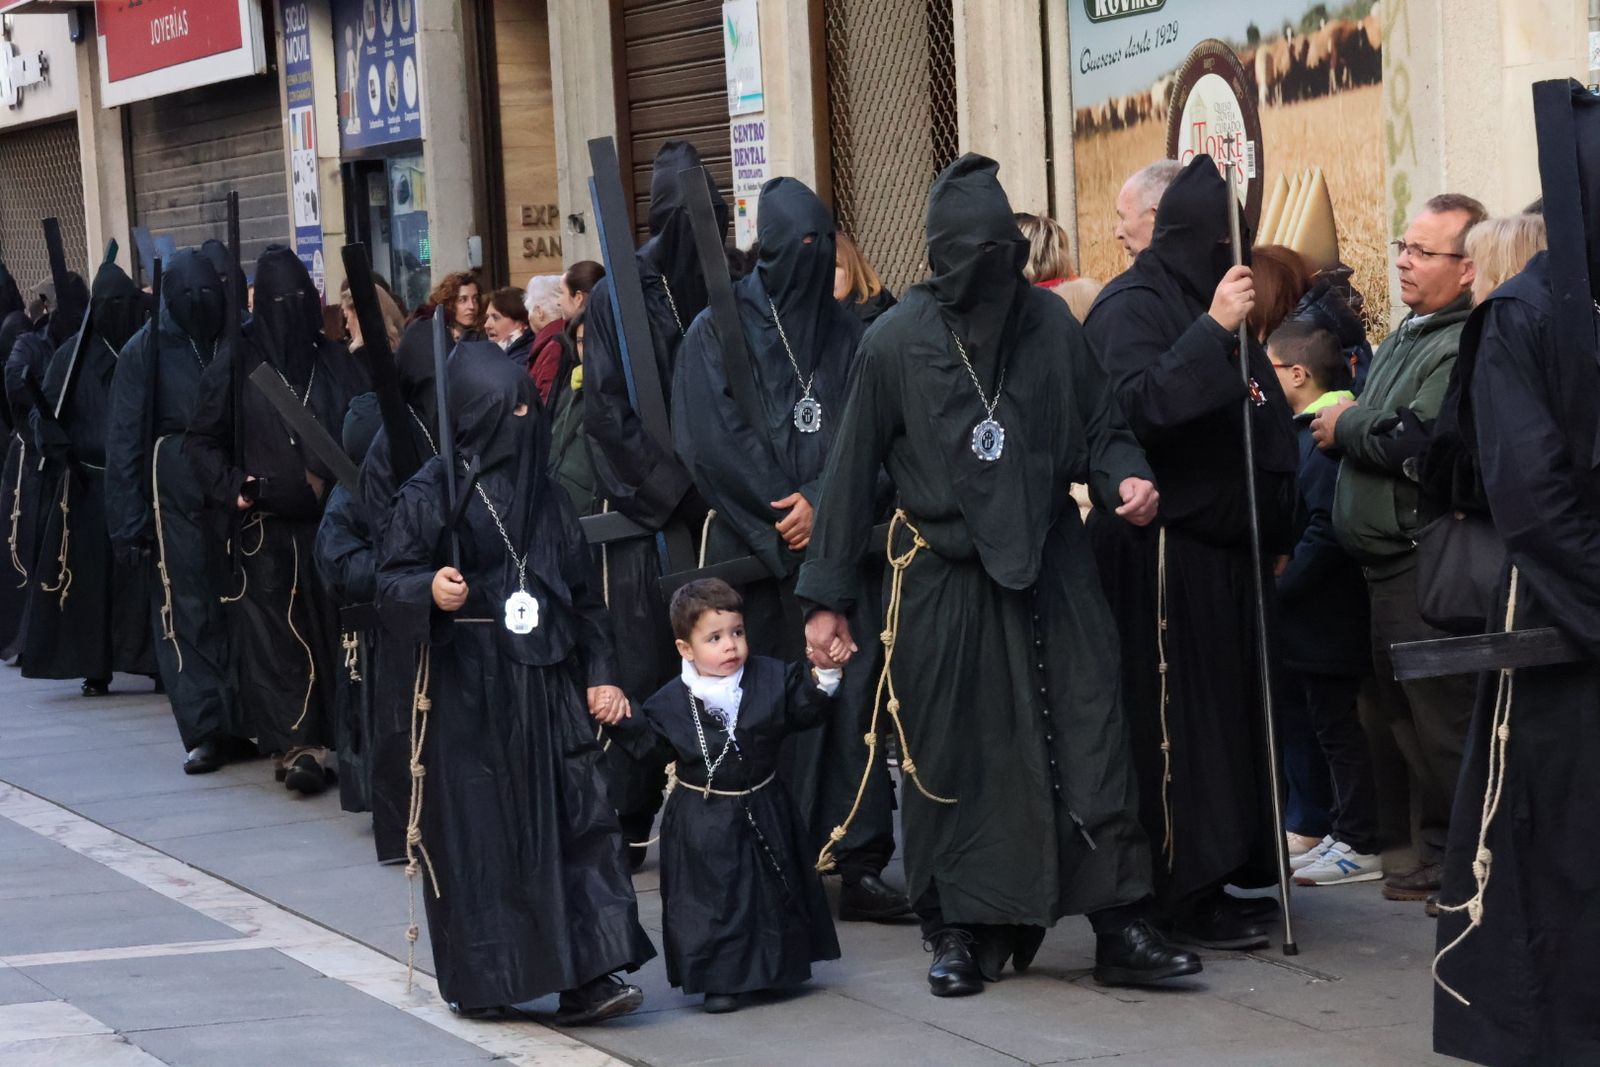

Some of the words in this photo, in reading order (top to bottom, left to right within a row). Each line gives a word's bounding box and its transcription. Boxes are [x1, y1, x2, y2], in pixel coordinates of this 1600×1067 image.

[150, 6, 188, 46] JOYERÍAS
[285, 3, 307, 34] SIGLO
[1124, 29, 1151, 59] desde
[1155, 20, 1179, 48] 1929
[733, 122, 765, 143] CENTRO
[734, 145, 766, 166] DENTAL
[521, 204, 559, 227] EXP
[522, 235, 562, 258] SAN
